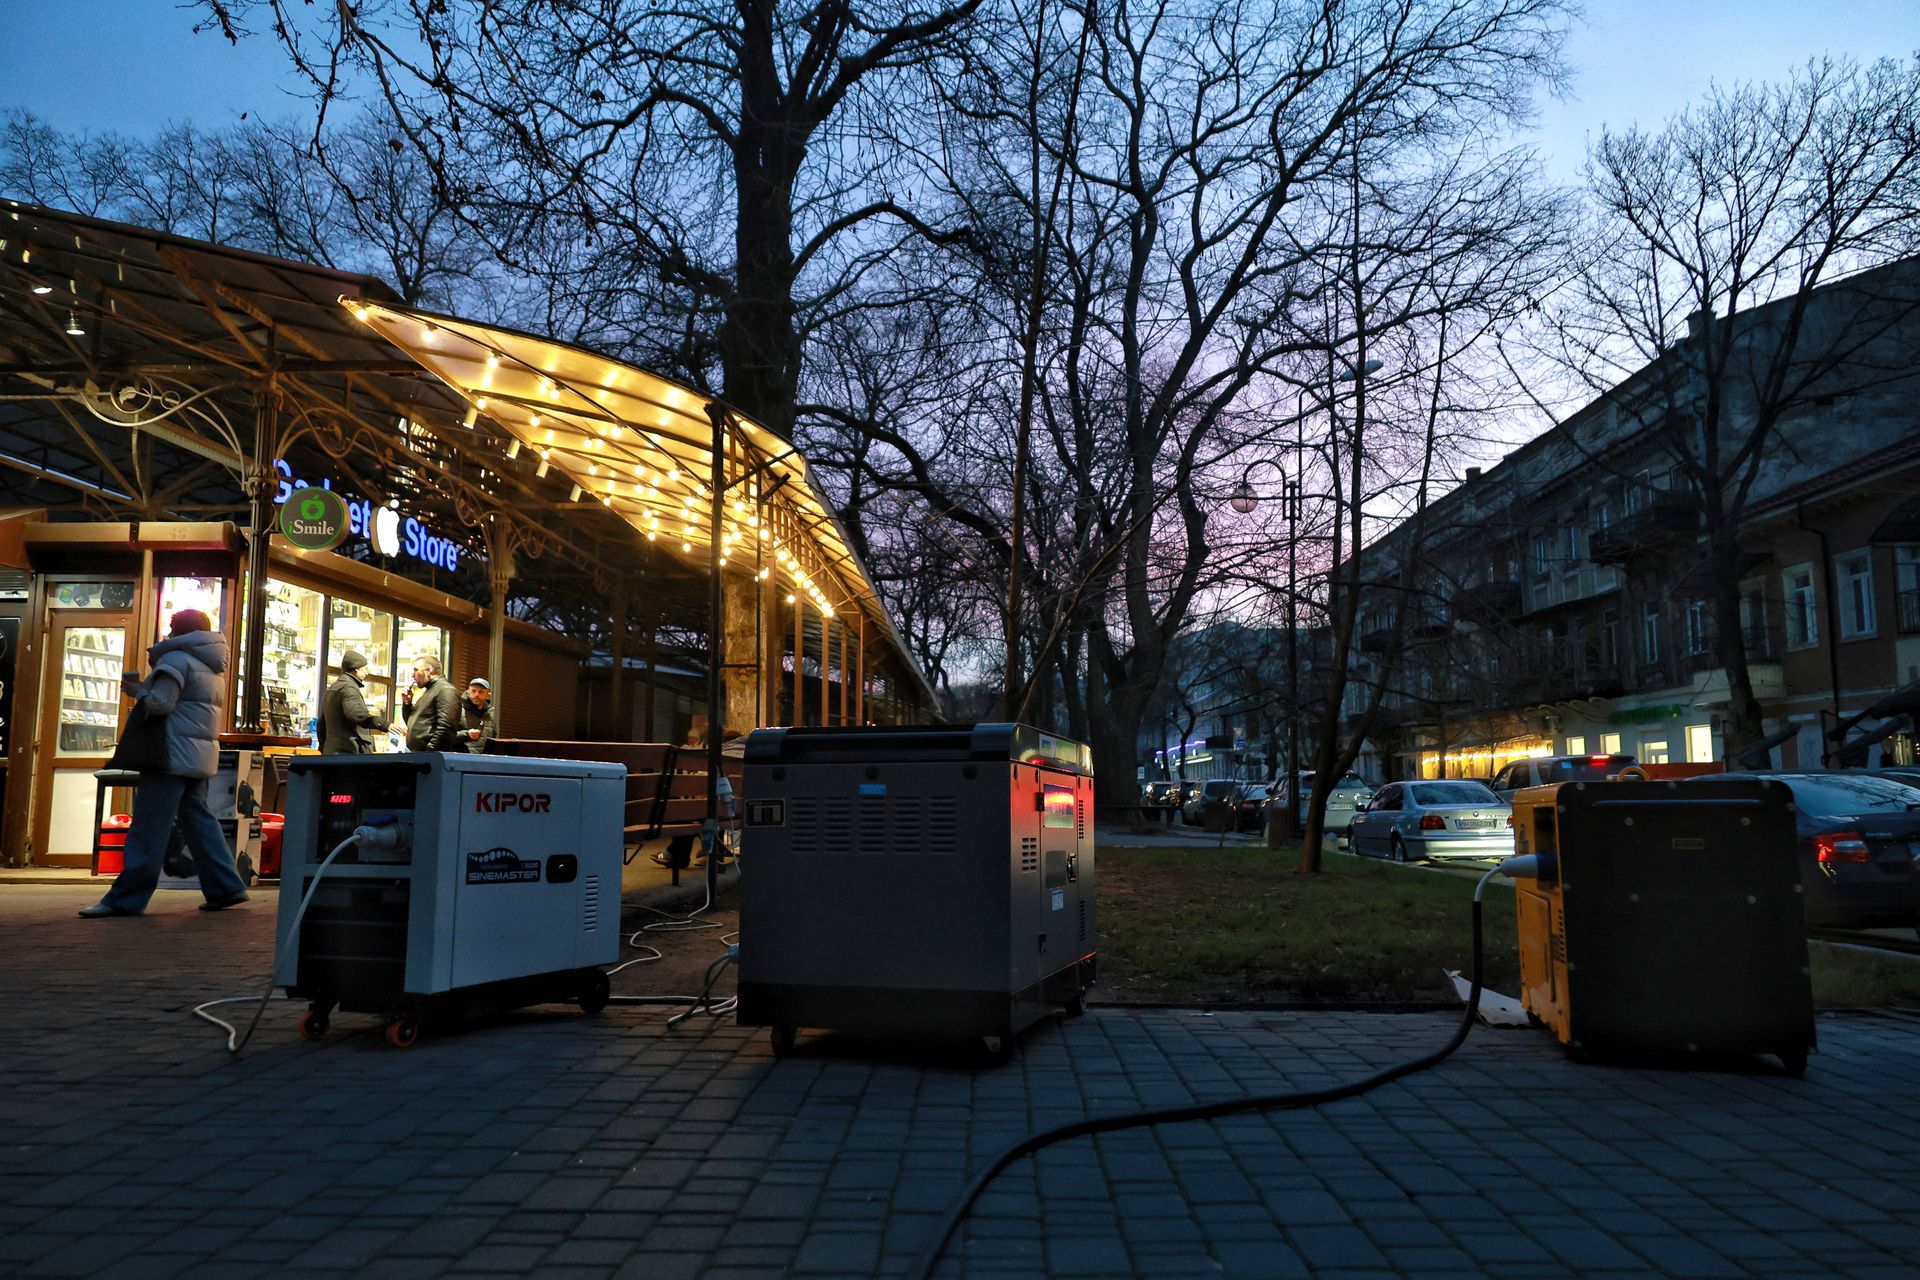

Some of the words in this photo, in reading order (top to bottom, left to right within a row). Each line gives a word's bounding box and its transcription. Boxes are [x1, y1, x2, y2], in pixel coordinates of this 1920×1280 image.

[288, 520, 335, 536] iSmile
[405, 516, 459, 572] Store
[476, 792, 552, 813] KIPOR
[468, 870, 538, 881] SINEMASTER
